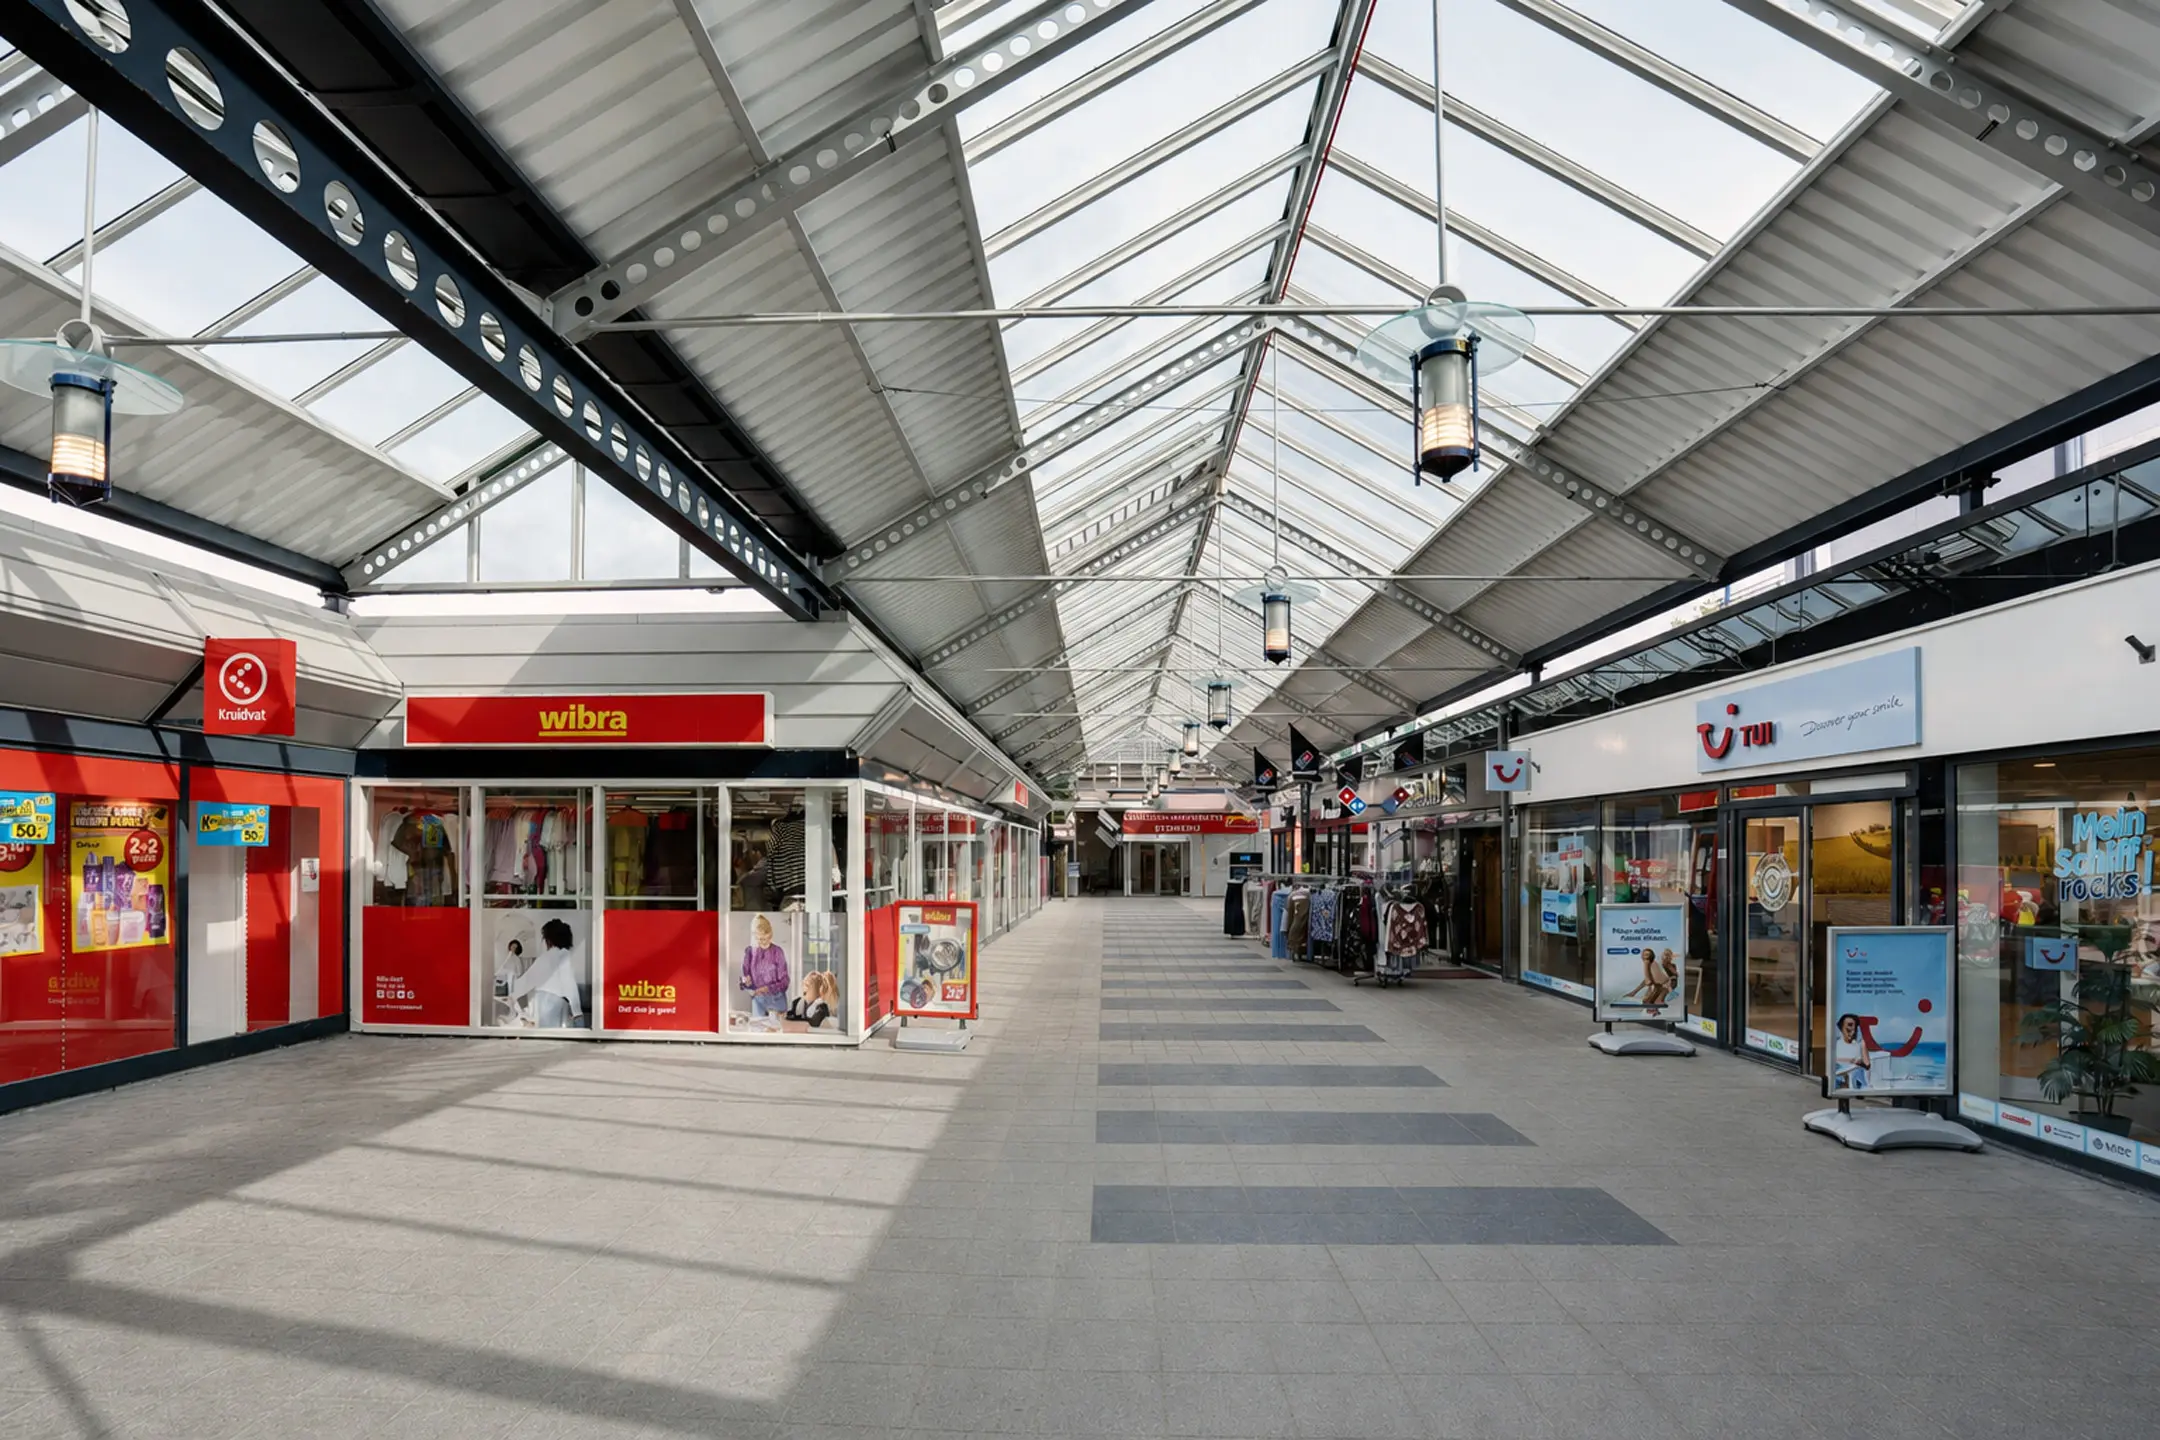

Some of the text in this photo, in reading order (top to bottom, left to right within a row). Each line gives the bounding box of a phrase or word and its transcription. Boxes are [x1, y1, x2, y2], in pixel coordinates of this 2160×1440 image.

[218, 709, 267, 721] Kruidvat
[539, 704, 627, 736] wibra
[1847, 708, 1870, 731] your
[1872, 694, 1904, 715] smile
[1740, 721, 1773, 747] TUI
[2053, 837, 2142, 878] Schiff
[618, 980, 676, 1002] wibra
